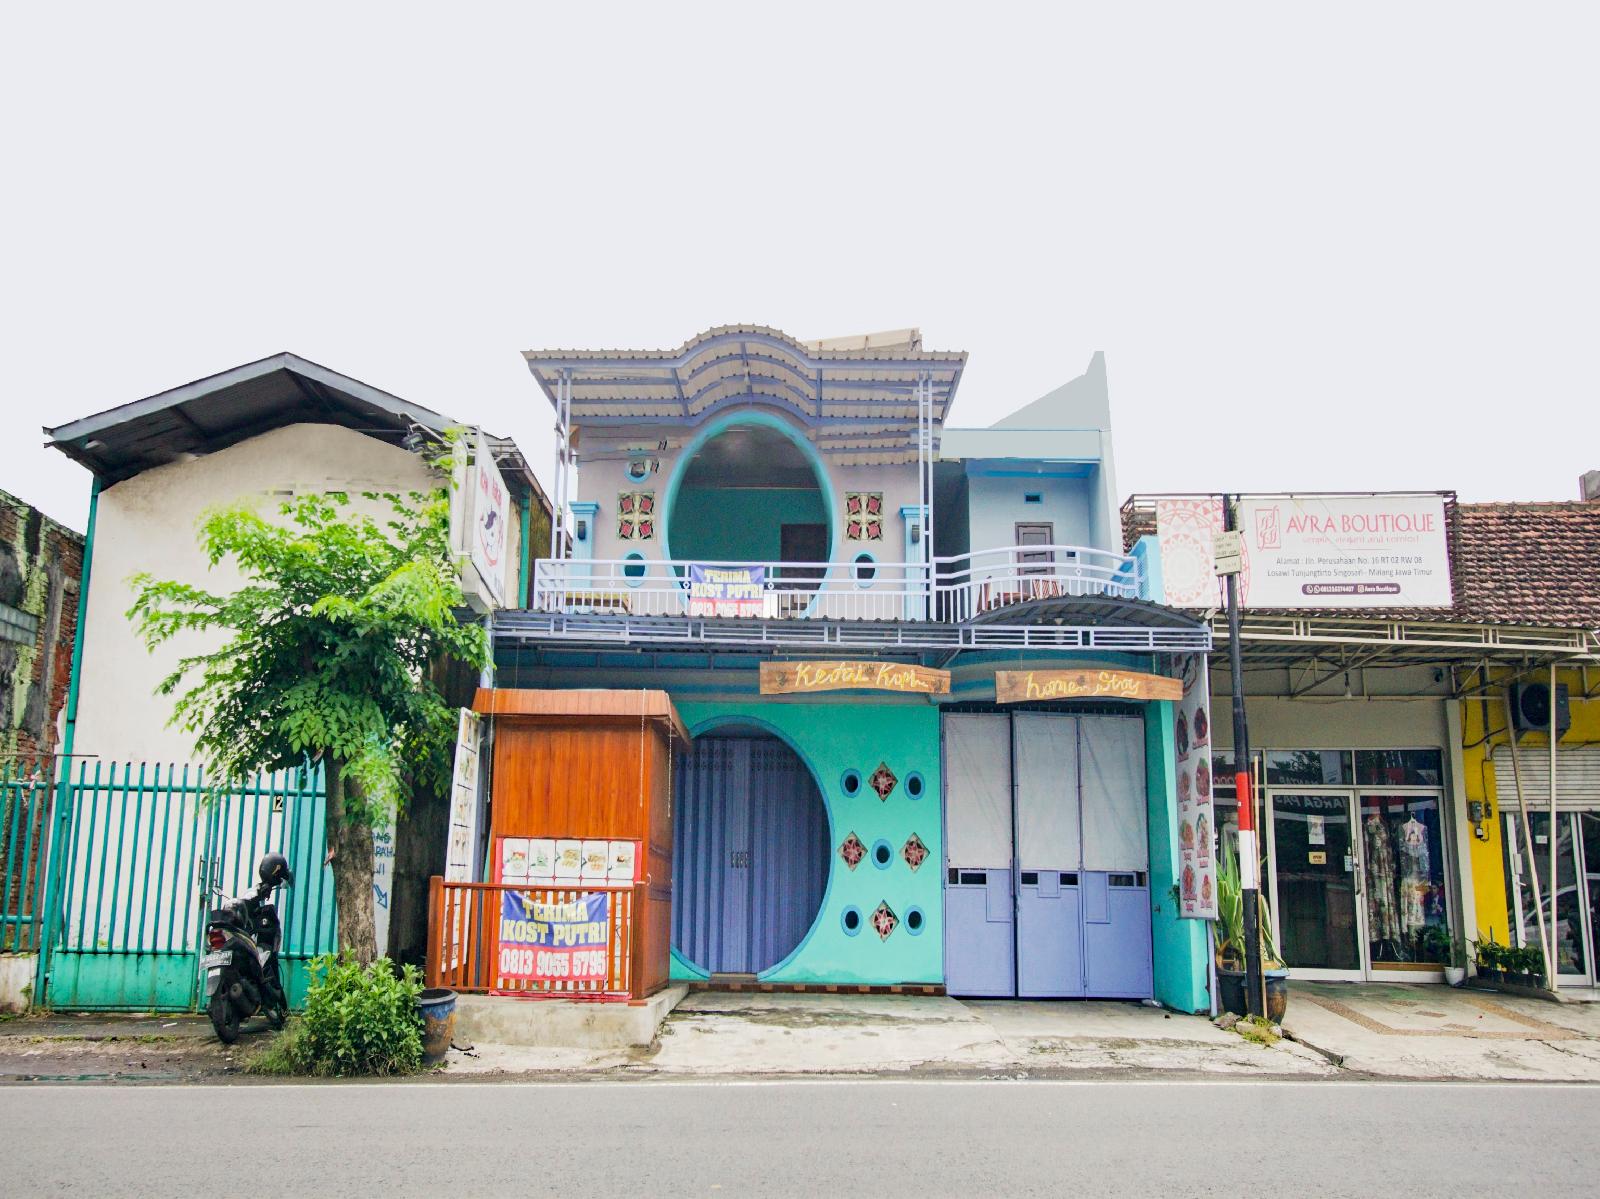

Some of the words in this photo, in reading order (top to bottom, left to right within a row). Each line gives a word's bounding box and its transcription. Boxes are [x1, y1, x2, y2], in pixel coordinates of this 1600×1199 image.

[1286, 514, 1337, 533] AVRA
[1341, 513, 1435, 533] BOUTIQUE
[1380, 556, 1389, 564] RT
[1400, 556, 1412, 564] RW
[1413, 568, 1433, 576] Timur
[691, 582, 724, 598] KOST
[726, 583, 764, 599] PUTRI
[522, 899, 588, 923] TERIMA
[502, 919, 549, 944] KOST
[552, 921, 607, 946] PUTRI
[501, 948, 534, 975] 0813
[536, 950, 570, 977] 9055
[572, 950, 606, 977] 5795
